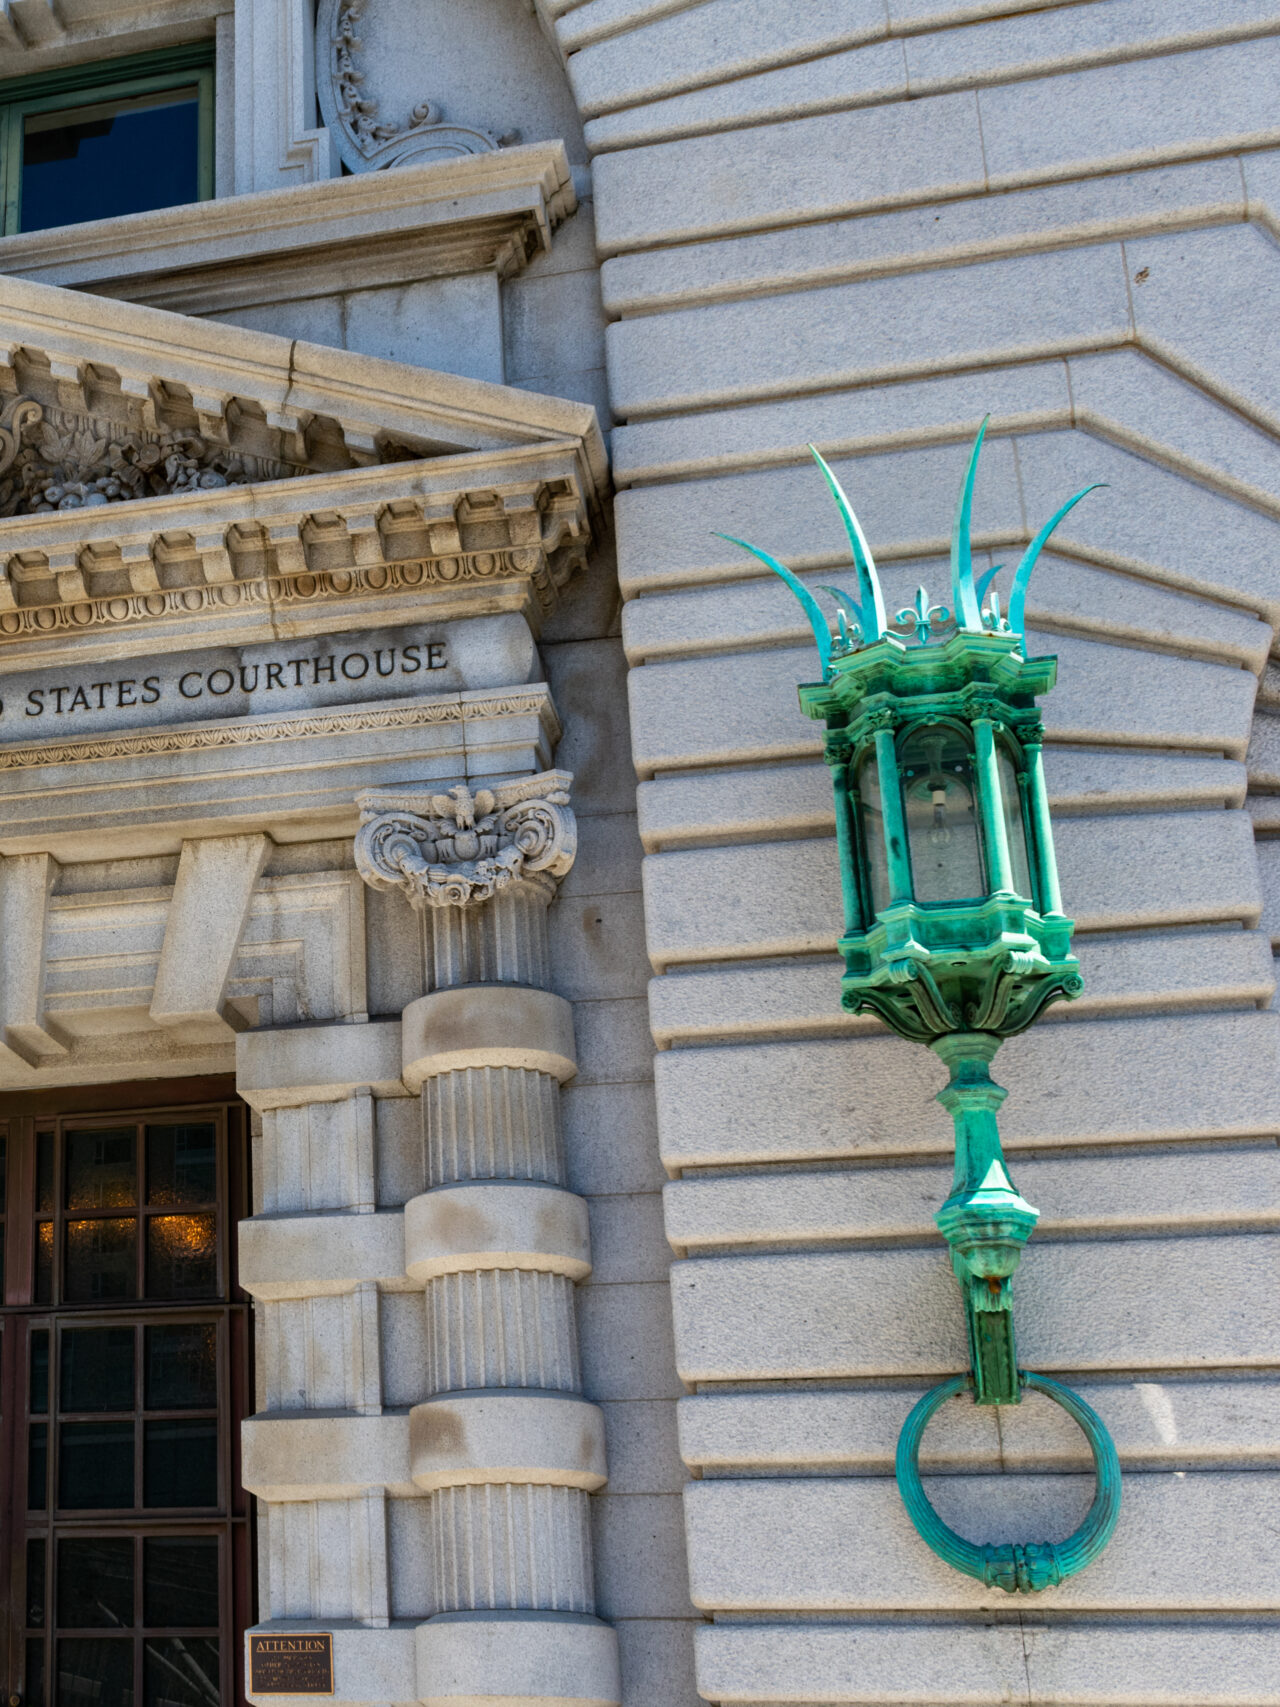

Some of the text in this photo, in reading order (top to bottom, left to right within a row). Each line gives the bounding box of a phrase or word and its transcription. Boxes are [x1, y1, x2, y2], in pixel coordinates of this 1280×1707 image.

[25, 676, 161, 717] STATES
[178, 641, 449, 699] COURTHOUSE
[256, 1640, 326, 1652] ATTENTION
